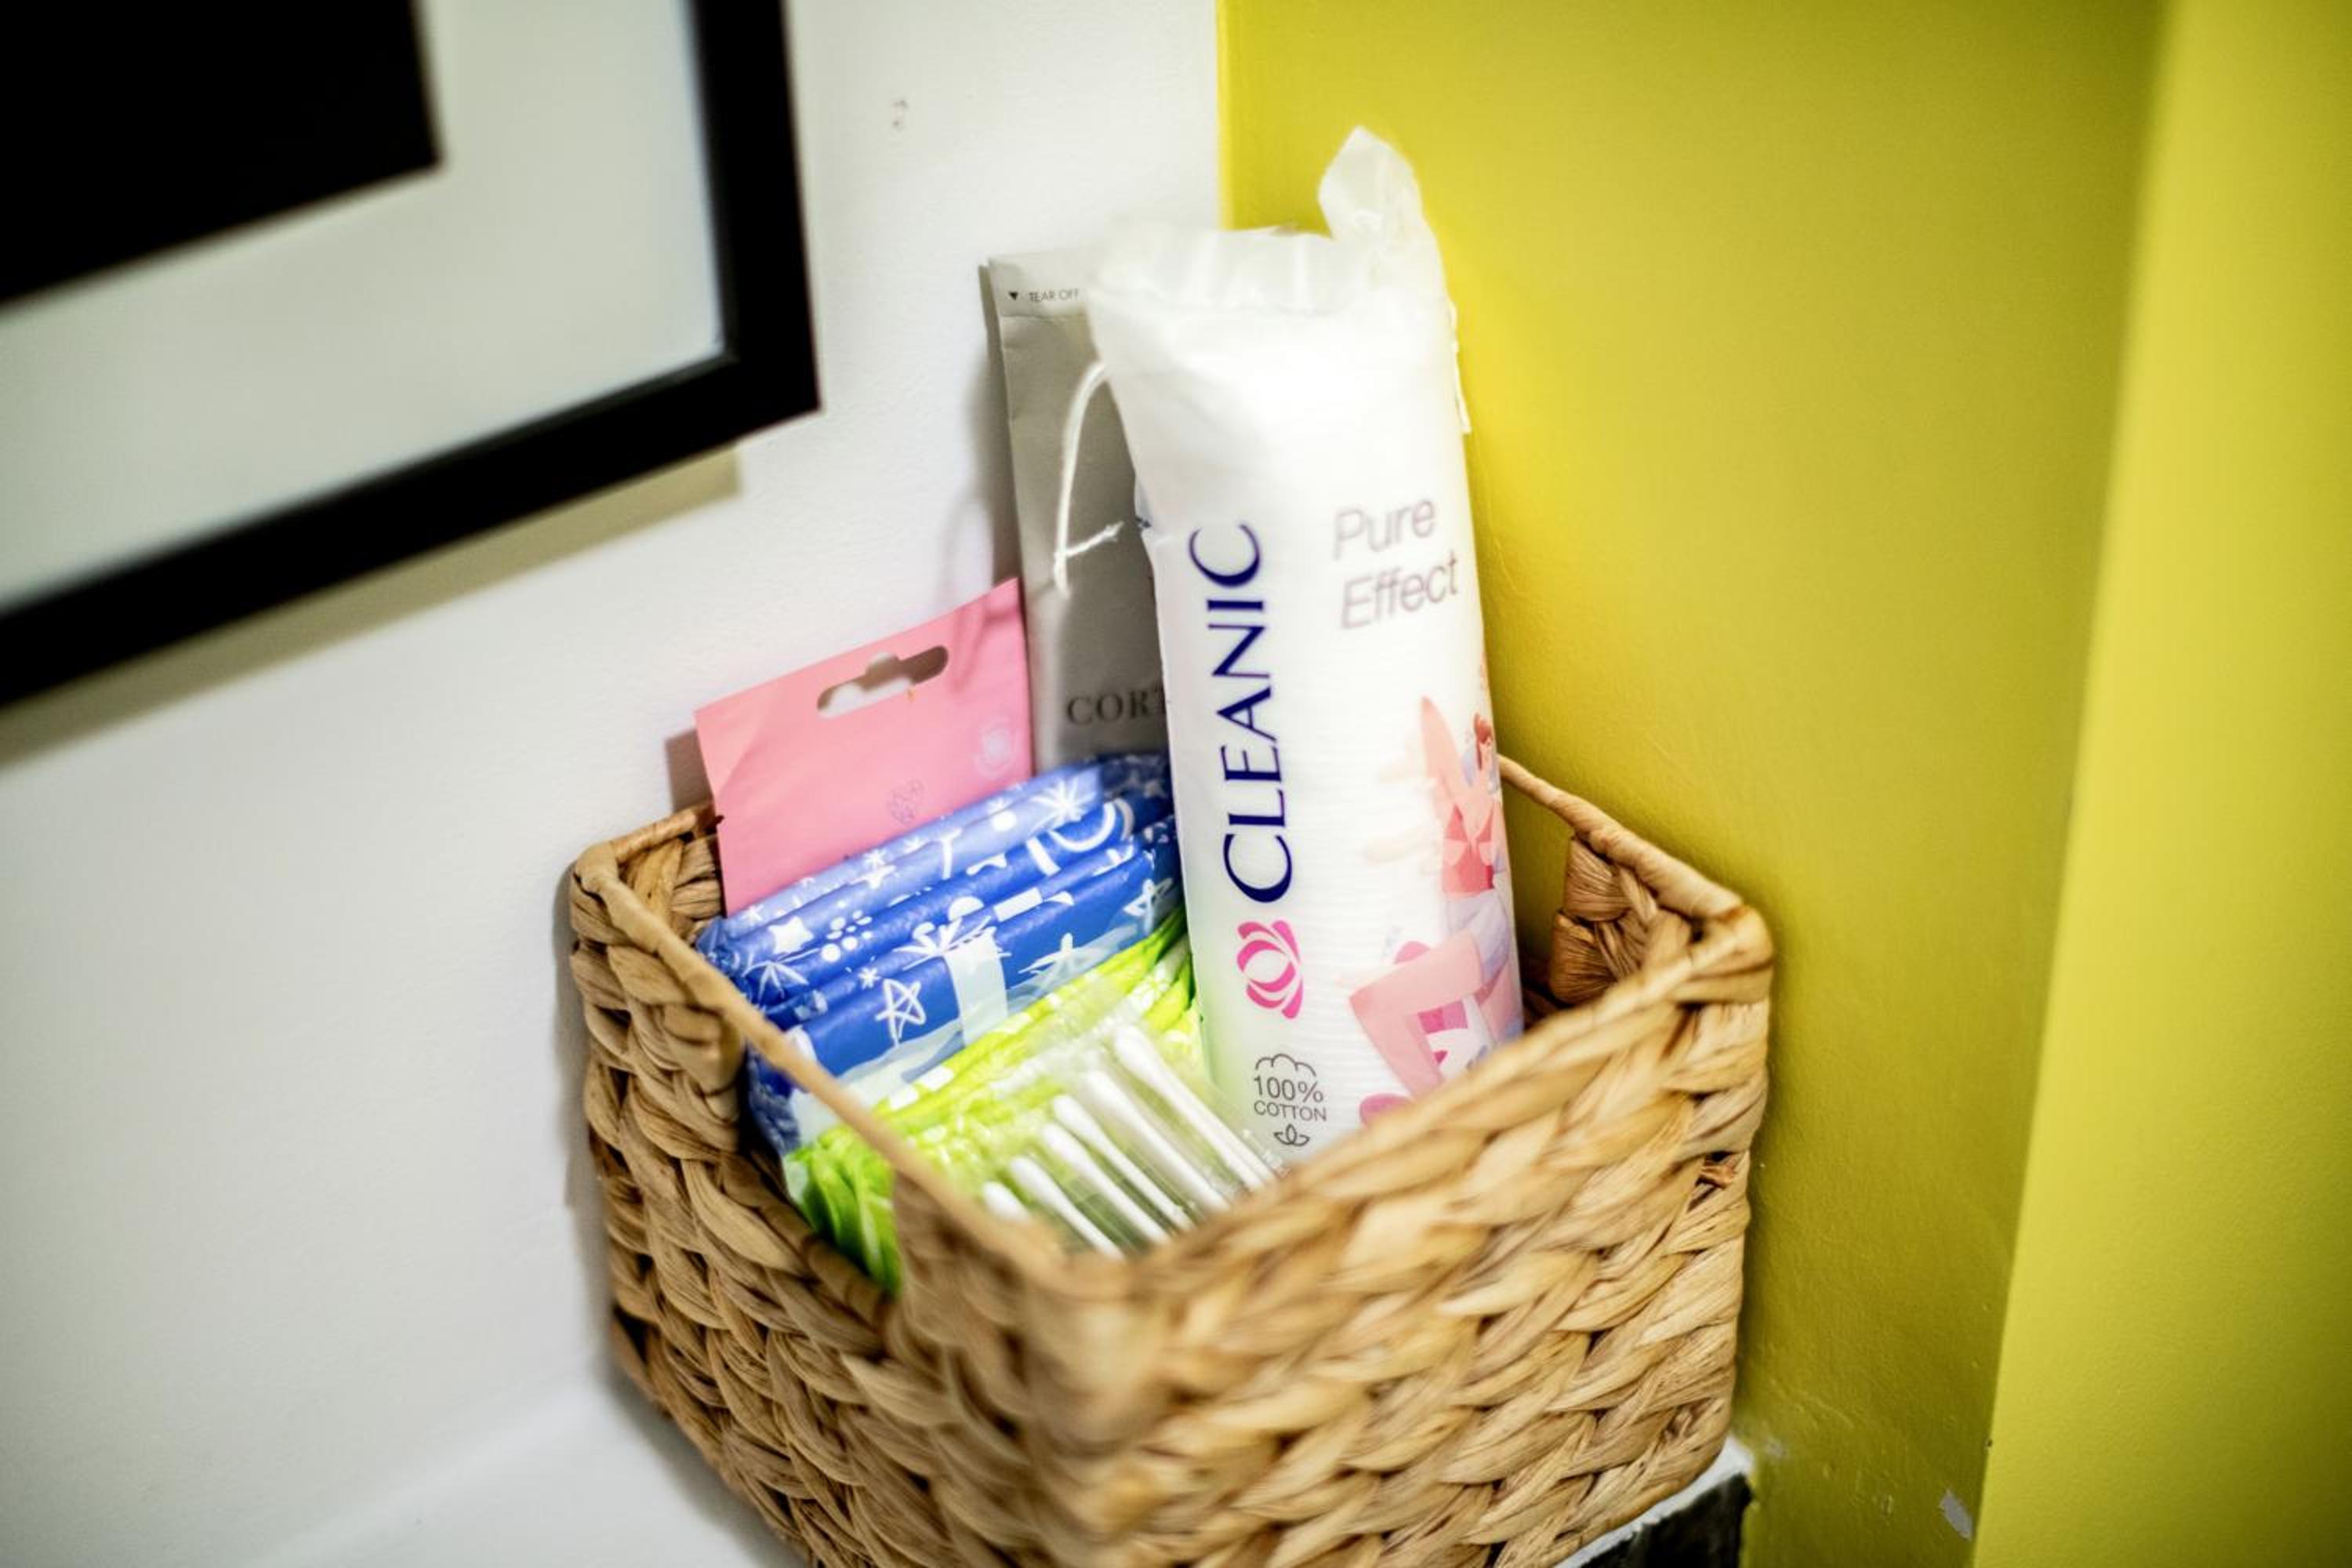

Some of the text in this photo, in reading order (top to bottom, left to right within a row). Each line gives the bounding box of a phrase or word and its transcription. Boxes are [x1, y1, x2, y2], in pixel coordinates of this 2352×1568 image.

[1029, 288, 1080, 303] TEAR OFF
[1334, 499, 1436, 561] Pure
[1341, 548, 1457, 630] Effect
[1189, 523, 1293, 903] CLEANIC
[1254, 1074, 1325, 1104] 100%
[1254, 1099, 1327, 1122] COTTON
